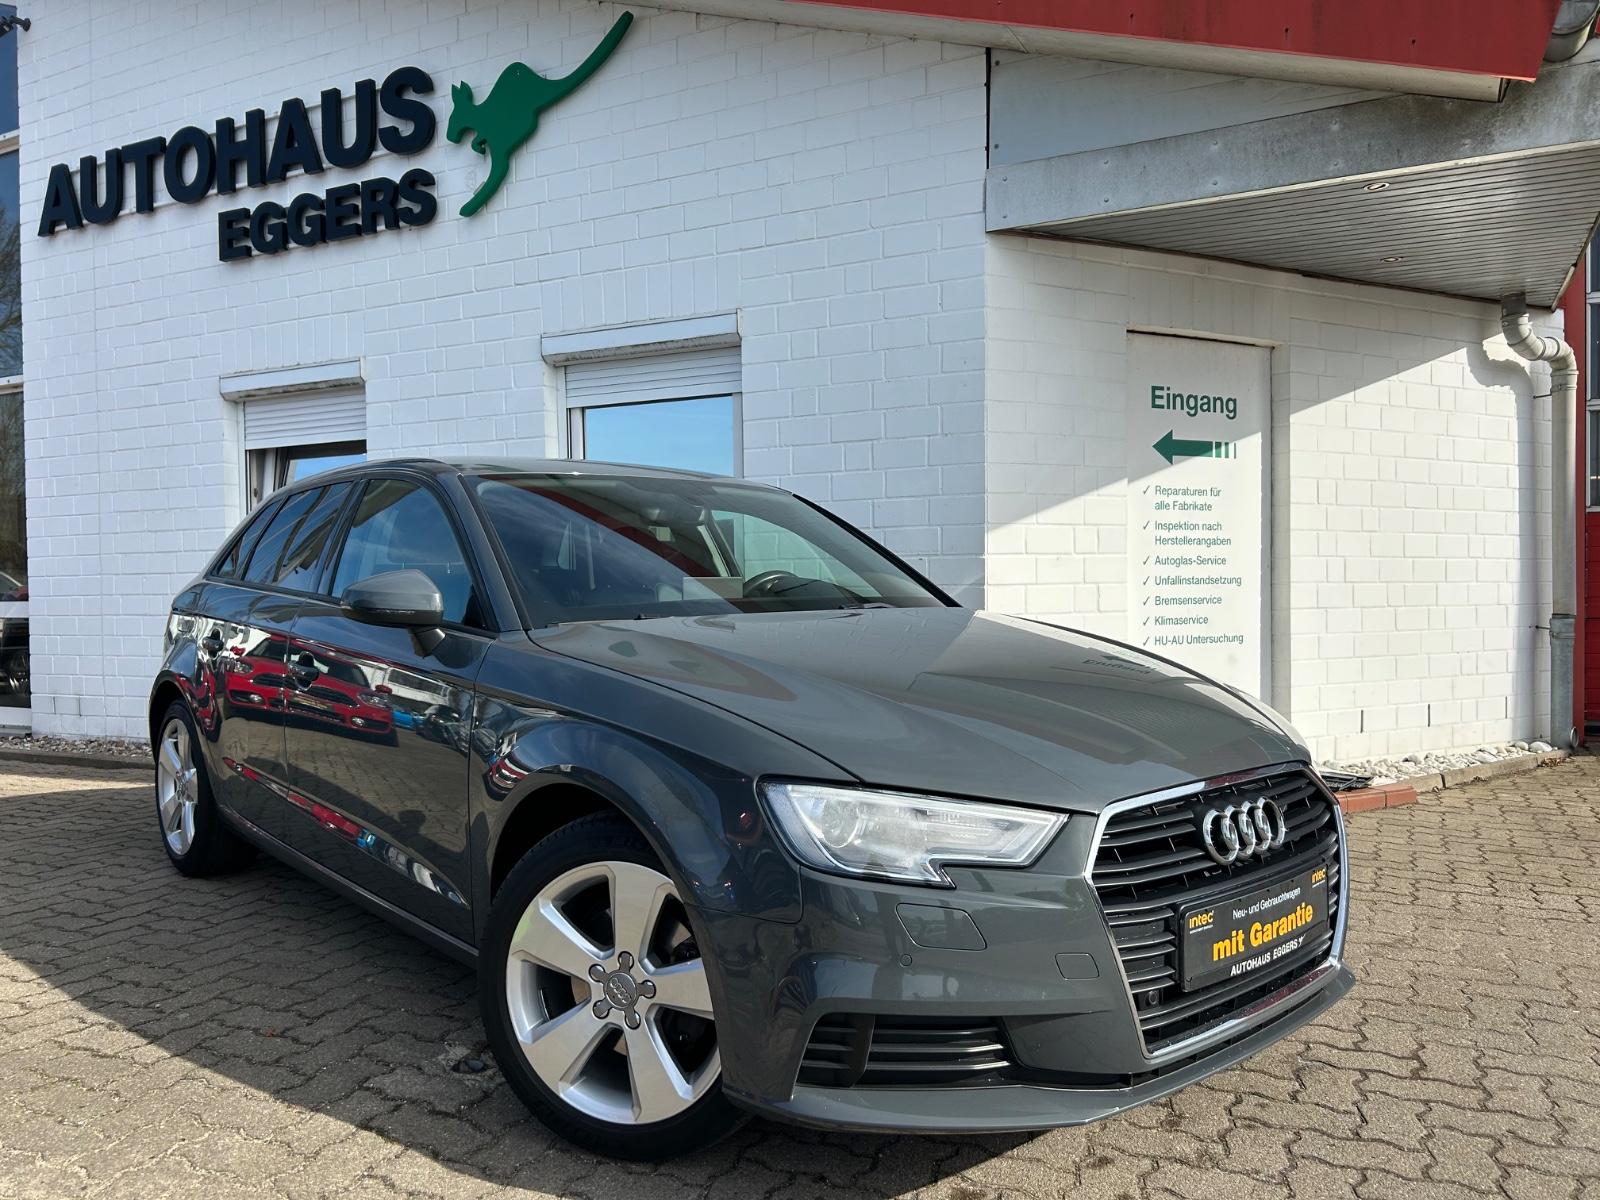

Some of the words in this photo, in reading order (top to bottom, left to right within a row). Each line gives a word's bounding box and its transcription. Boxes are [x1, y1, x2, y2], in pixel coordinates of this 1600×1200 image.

[37, 66, 436, 238] AUTOHAUS
[218, 168, 437, 262] EGGERS
[1151, 385, 1237, 420] Eingang
[1154, 486, 1208, 498] Reparaturen
[1209, 487, 1222, 497] für
[1154, 501, 1170, 511] alle
[1172, 501, 1213, 512] Fabrikate
[1155, 520, 1200, 533] Inspektion
[1201, 521, 1222, 531] nach
[1155, 535, 1232, 548] Herstellerangaben
[1154, 555, 1227, 568] Autoglas-Service
[1155, 575, 1242, 587] Unfallinstandsetzung
[1154, 594, 1223, 606] Bremsenservice
[1154, 614, 1209, 626] Klimaservice
[1154, 635, 1185, 646] HU-AU
[1186, 633, 1244, 645] Untersuchung
[1232, 908, 1248, 920] Neu-
[1249, 902, 1260, 914] und
[1260, 887, 1301, 909] Gebrauchtwagen
[1213, 929, 1245, 961] mit
[1249, 901, 1313, 947] Garantie
[1230, 952, 1271, 976] AUTOHAUS
[1272, 938, 1298, 959] EGGERS
